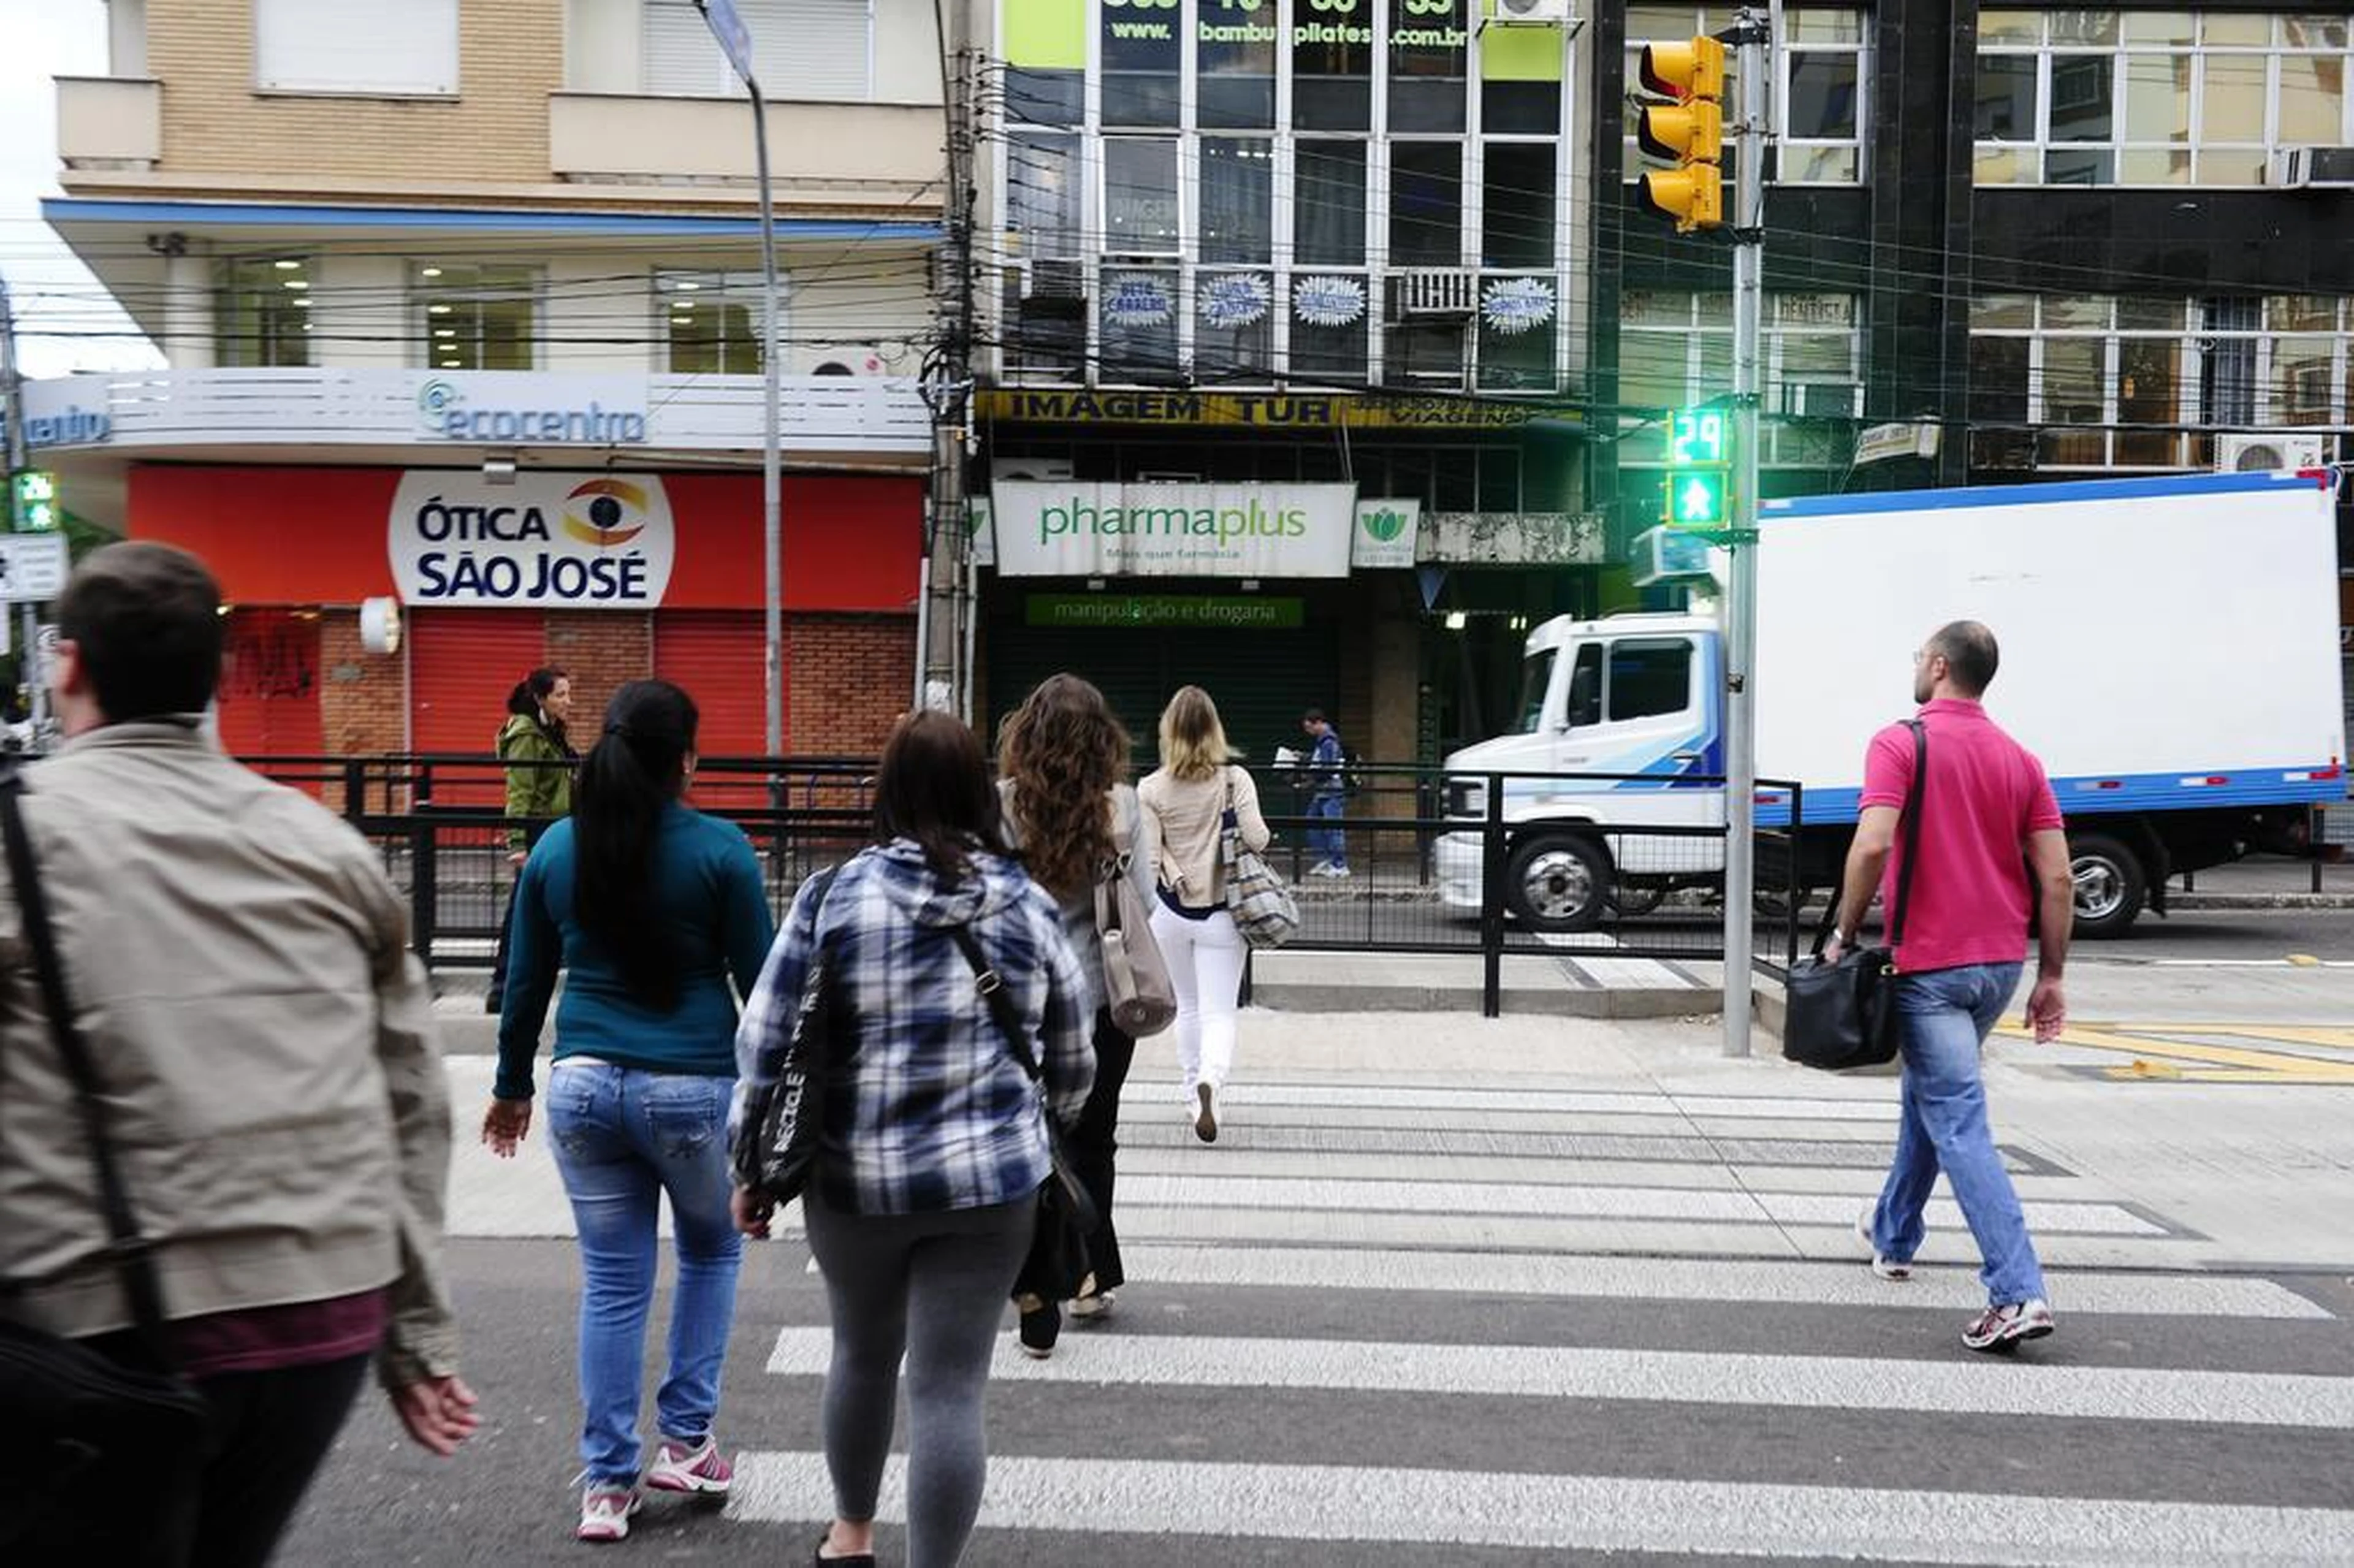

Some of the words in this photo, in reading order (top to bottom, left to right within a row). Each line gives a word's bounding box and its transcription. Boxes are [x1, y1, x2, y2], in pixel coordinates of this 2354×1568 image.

[1111, 23, 1171, 38] www.
[1199, 20, 1276, 41] bambu
[1294, 23, 1371, 46] pilates
[1388, 27, 1468, 47] .com.br
[443, 402, 646, 441] ecocentro
[1010, 395, 1202, 421] IMAGEM
[1234, 399, 1331, 423] TUR
[1675, 416, 1720, 463] 29
[417, 496, 551, 541] ÓTICA
[1042, 497, 1306, 546] pharmaplus
[418, 551, 521, 598] SÃO
[527, 550, 647, 599] JOSÉ
[1054, 599, 1176, 625] manipulação
[1182, 604, 1195, 618] e
[1199, 599, 1276, 625] drogaria
